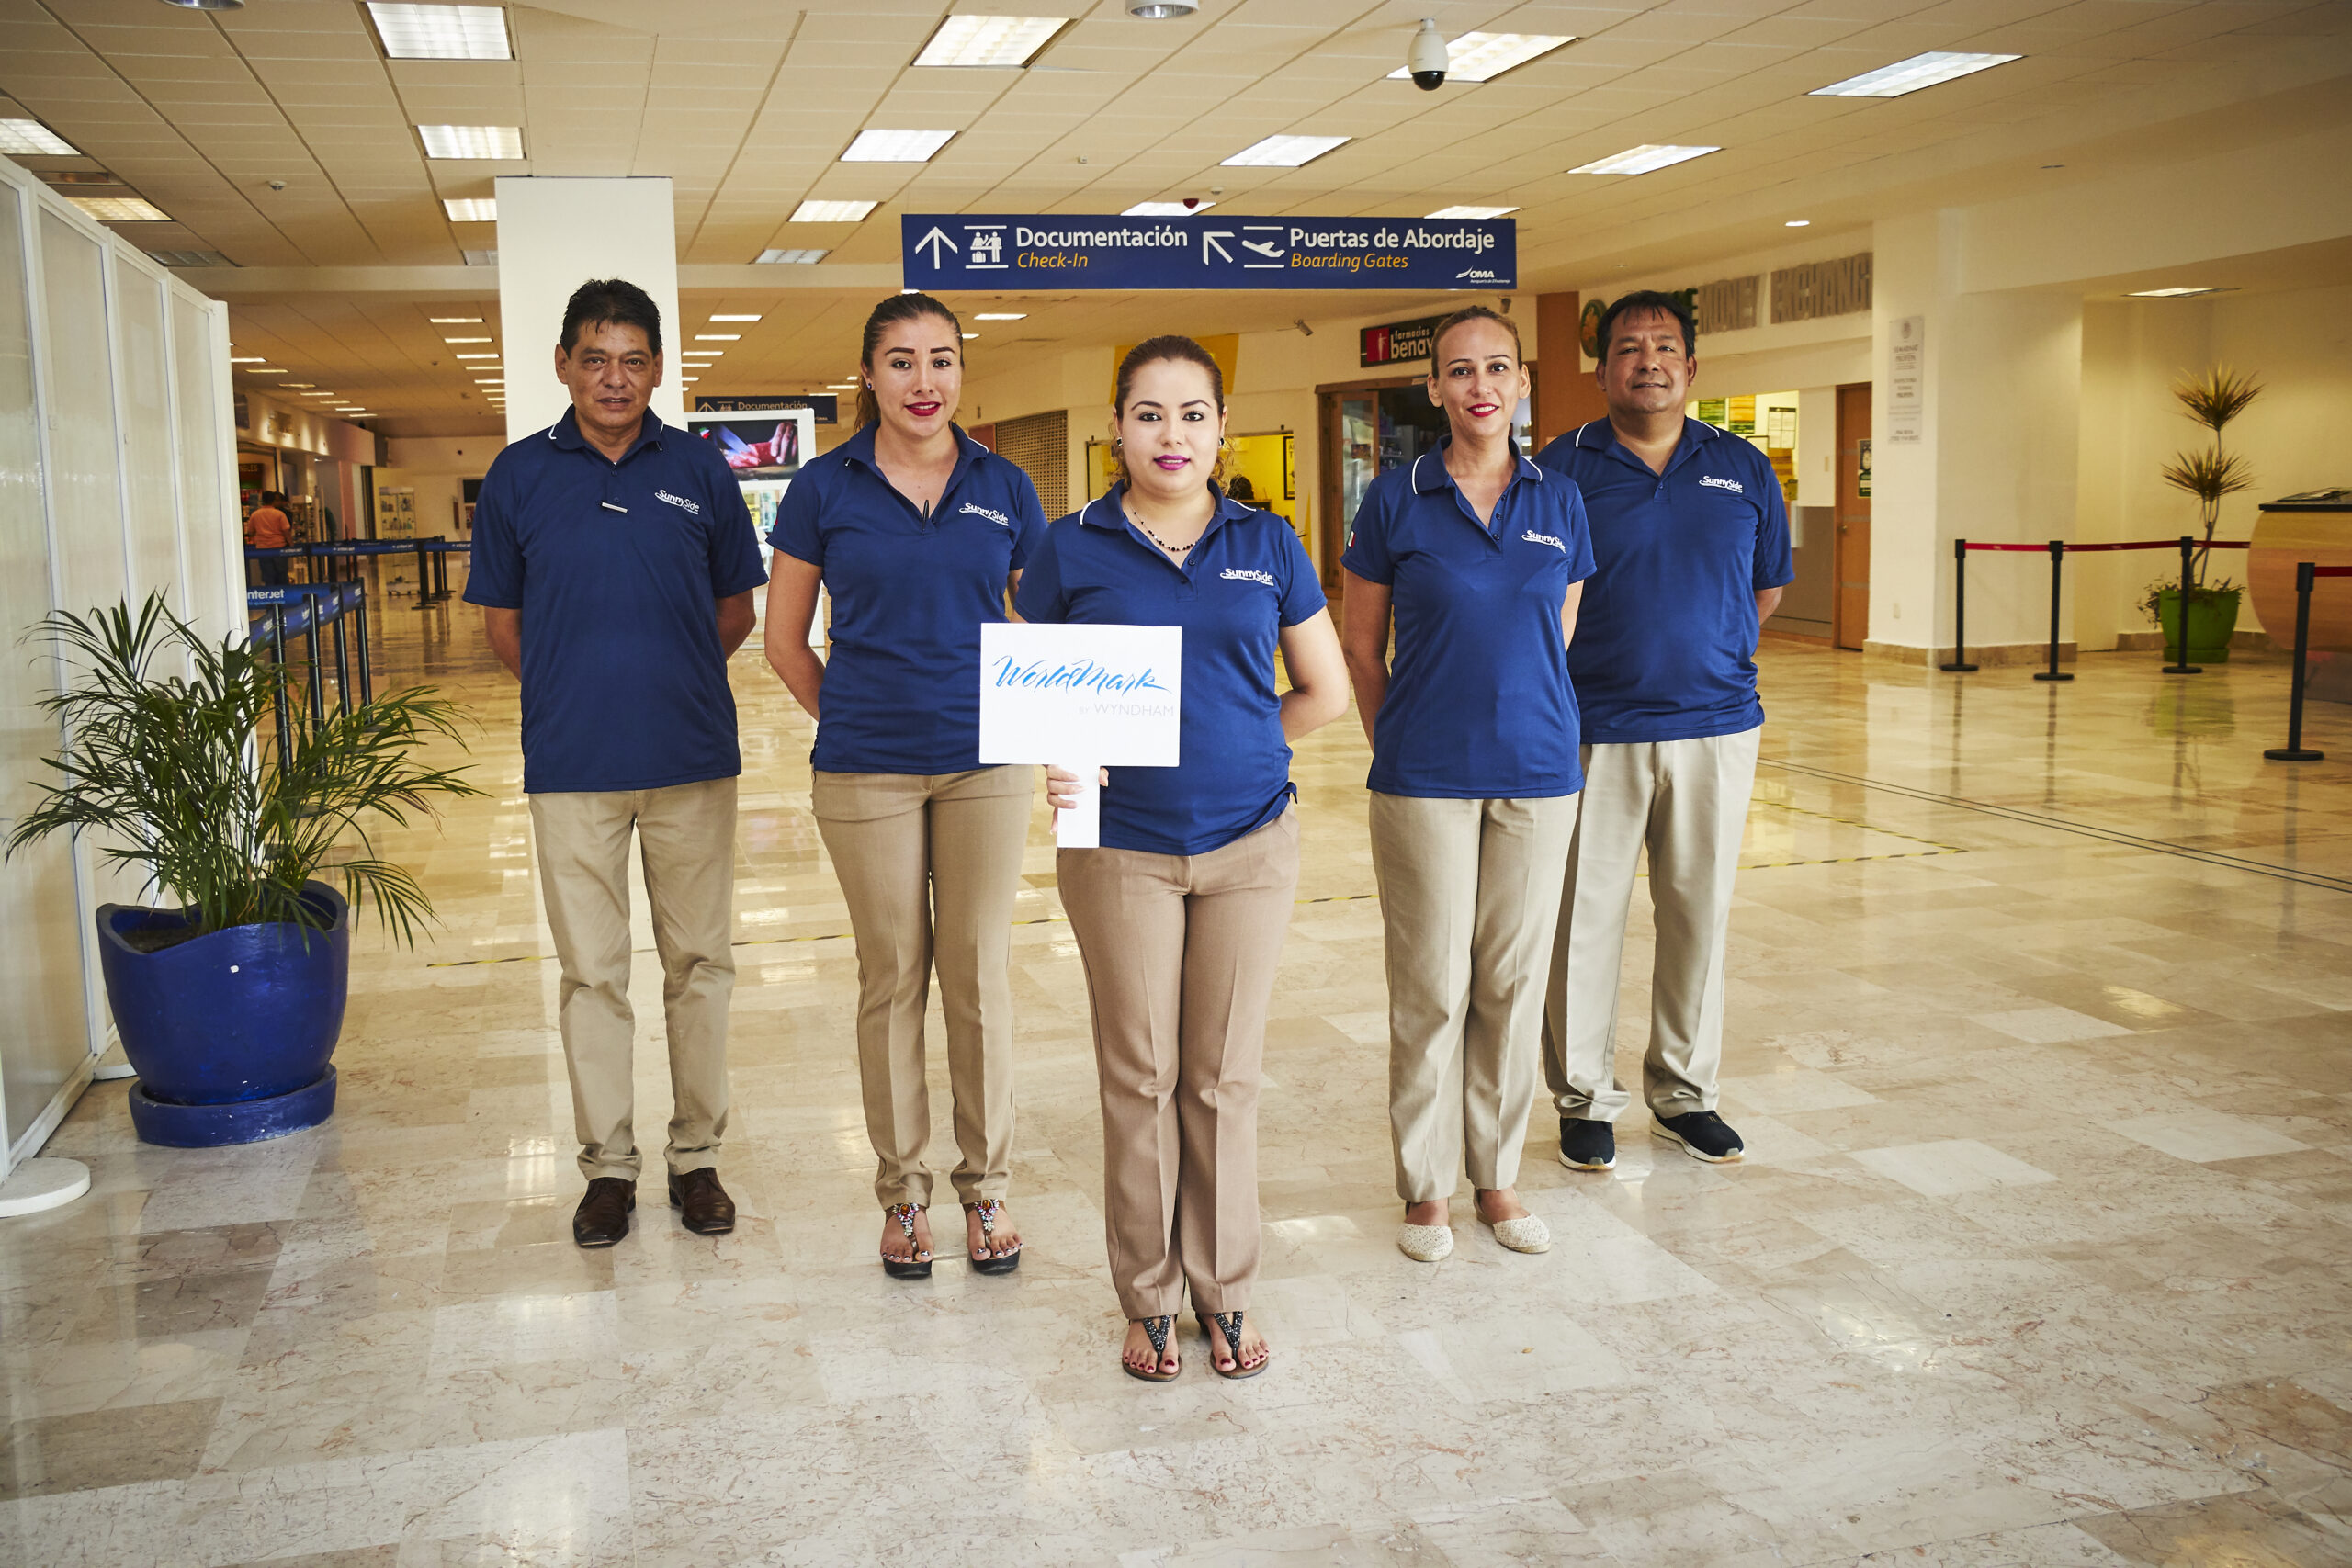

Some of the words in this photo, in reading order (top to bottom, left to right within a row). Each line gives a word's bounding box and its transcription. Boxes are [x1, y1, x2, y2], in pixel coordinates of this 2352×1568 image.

[1016, 225, 1188, 247] Documentación
[1290, 228, 1369, 248] Puertas
[1374, 227, 1399, 248] de
[1403, 227, 1495, 254] Abordaje
[1017, 252, 1089, 268] Check-In
[1291, 253, 1361, 273] Boarding
[1364, 253, 1408, 268] Gates
[1469, 270, 1495, 278] OMA
[1770, 253, 1873, 324] EXCHANG
[1395, 325, 1430, 340] farmacias
[1390, 334, 1434, 359] benav
[1702, 475, 1743, 491] SunnySide
[658, 489, 700, 513] SunnySide
[965, 502, 1009, 524] SunnySide
[1225, 568, 1273, 582] SunnySide
[246, 588, 285, 600] nterjet
[992, 655, 1172, 697] WorldMark
[1093, 703, 1175, 717] WYNDHAM
